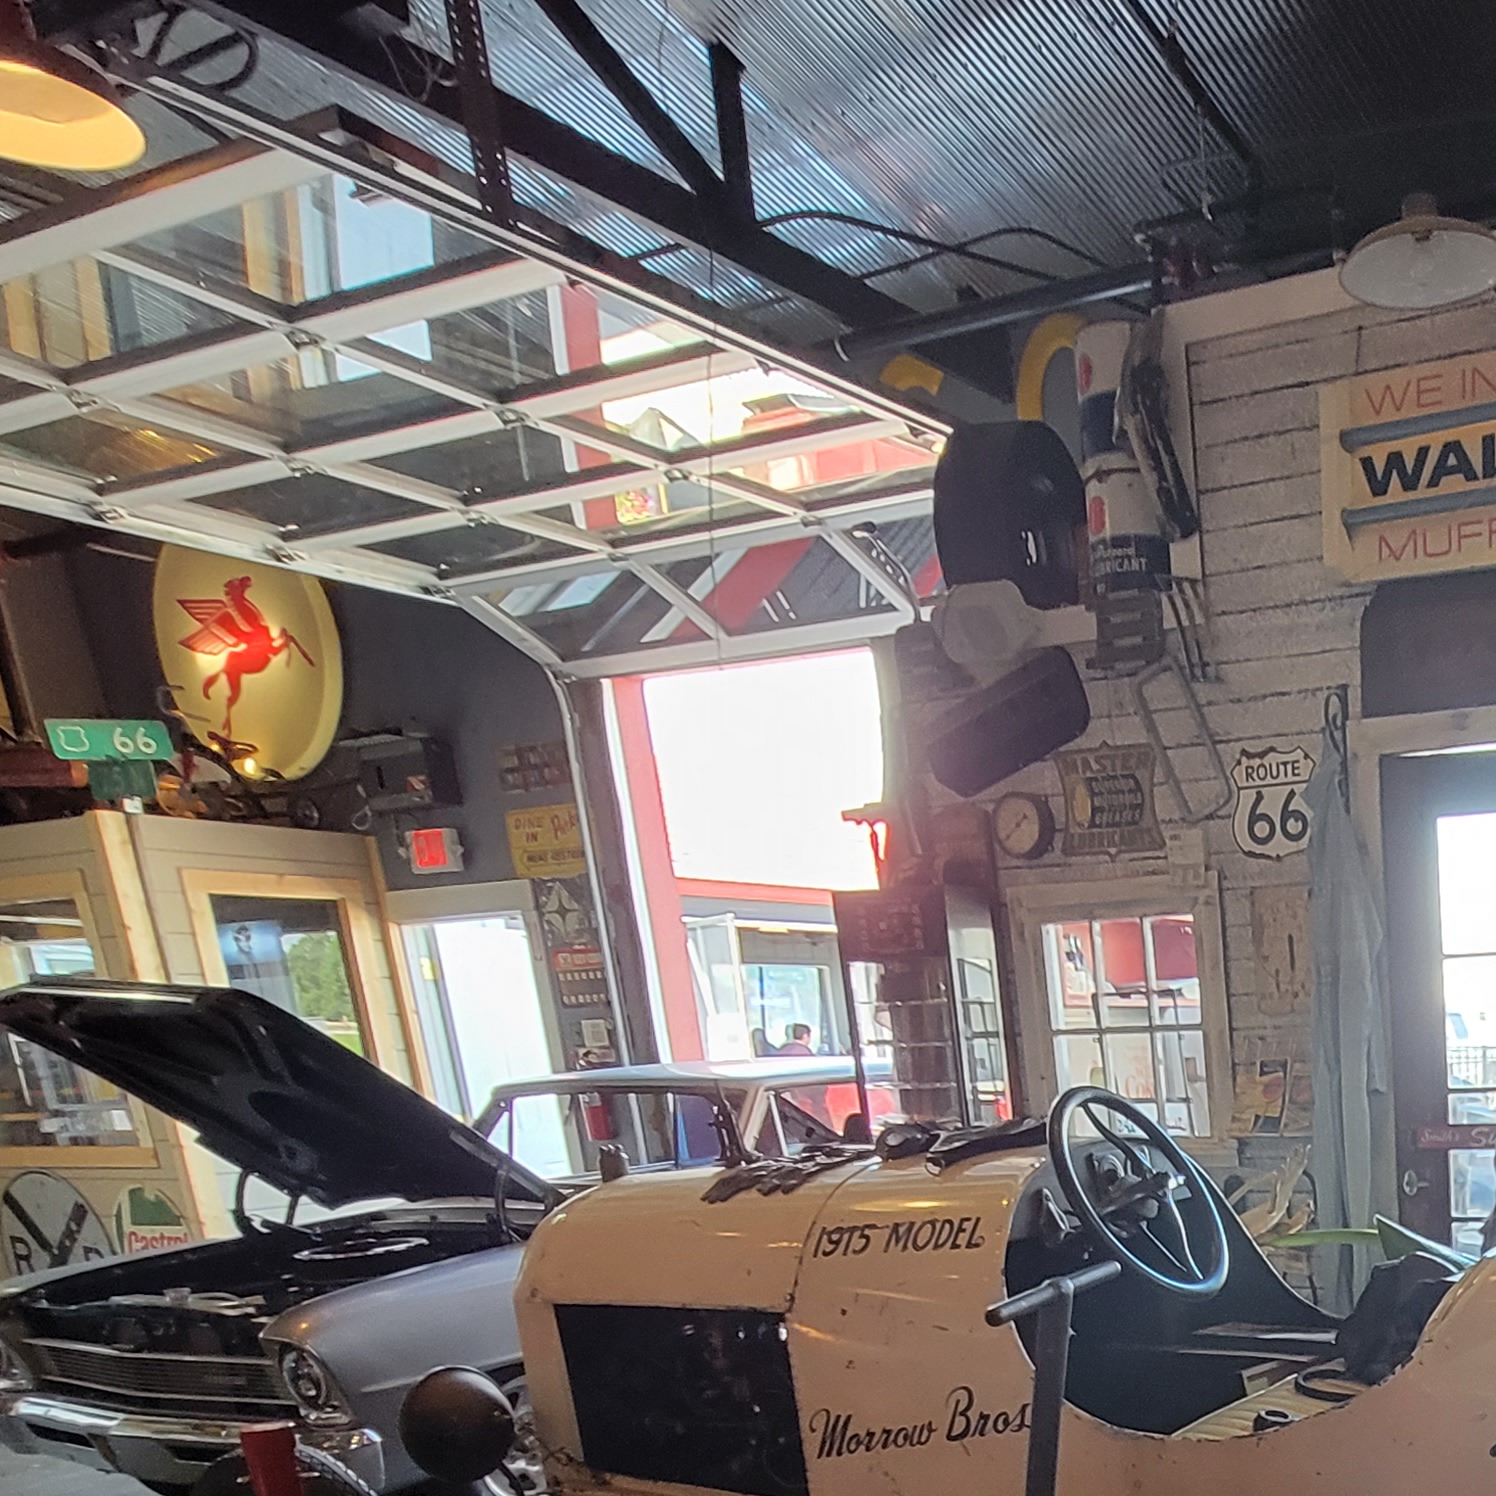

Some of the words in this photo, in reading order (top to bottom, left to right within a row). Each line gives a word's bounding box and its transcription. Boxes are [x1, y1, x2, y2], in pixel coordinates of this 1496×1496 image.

[1364, 373, 1443, 417] WE
[112, 726, 158, 754] 66
[1244, 759, 1302, 784] ROUTE
[1247, 787, 1310, 846] 66
[883, 1217, 985, 1253] MODEL
[808, 1408, 937, 1459] Morrow
[945, 1385, 1031, 1442] Bros
